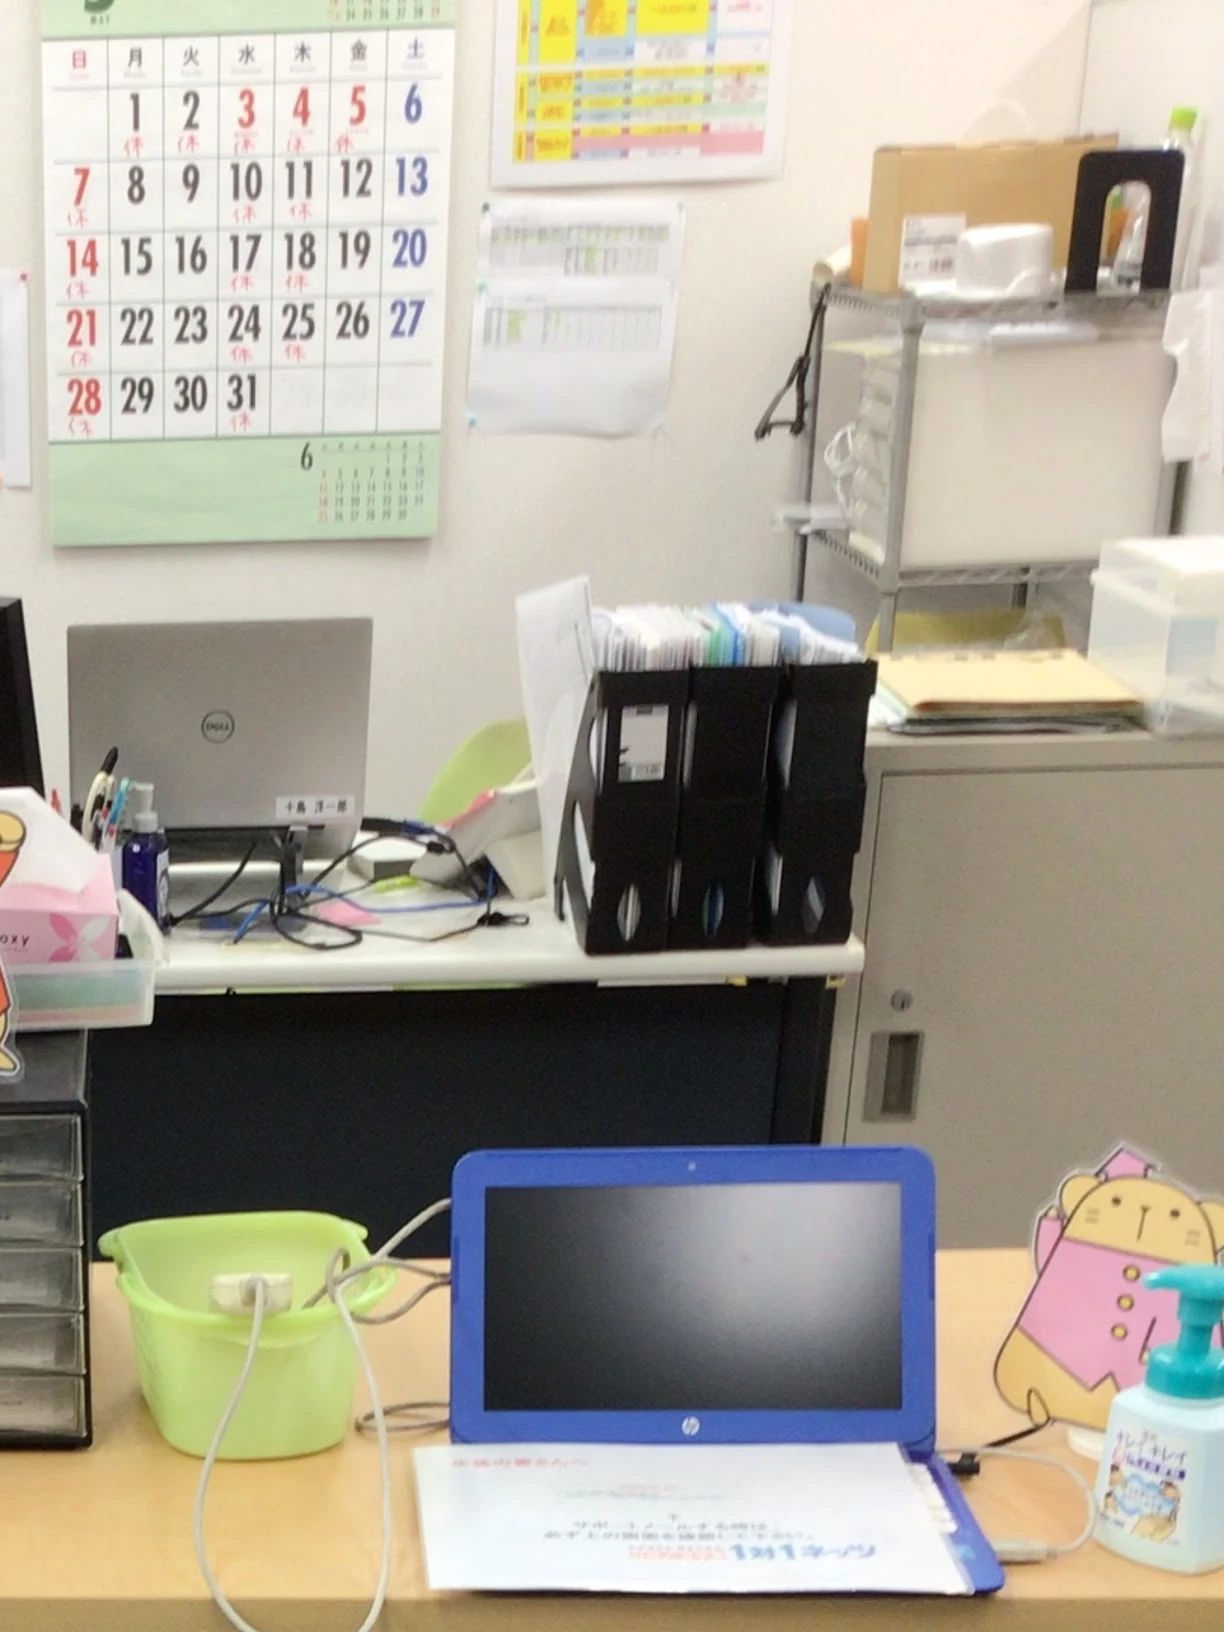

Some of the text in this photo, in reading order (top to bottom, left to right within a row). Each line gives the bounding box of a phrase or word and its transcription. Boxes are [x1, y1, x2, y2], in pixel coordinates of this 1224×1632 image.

[72, 39, 424, 69] 日 月 火 水 木 金 土
[129, 83, 423, 132] 1 2 3 4 5 6
[74, 156, 429, 206] 7 8 9 10 11 12 13
[67, 228, 427, 276] 14 15 16 17 18 19 20
[66, 299, 425, 346] 21 22 23 24 25 26 27
[67, 373, 257, 415] 28 29 30 31
[300, 440, 313, 471] 6
